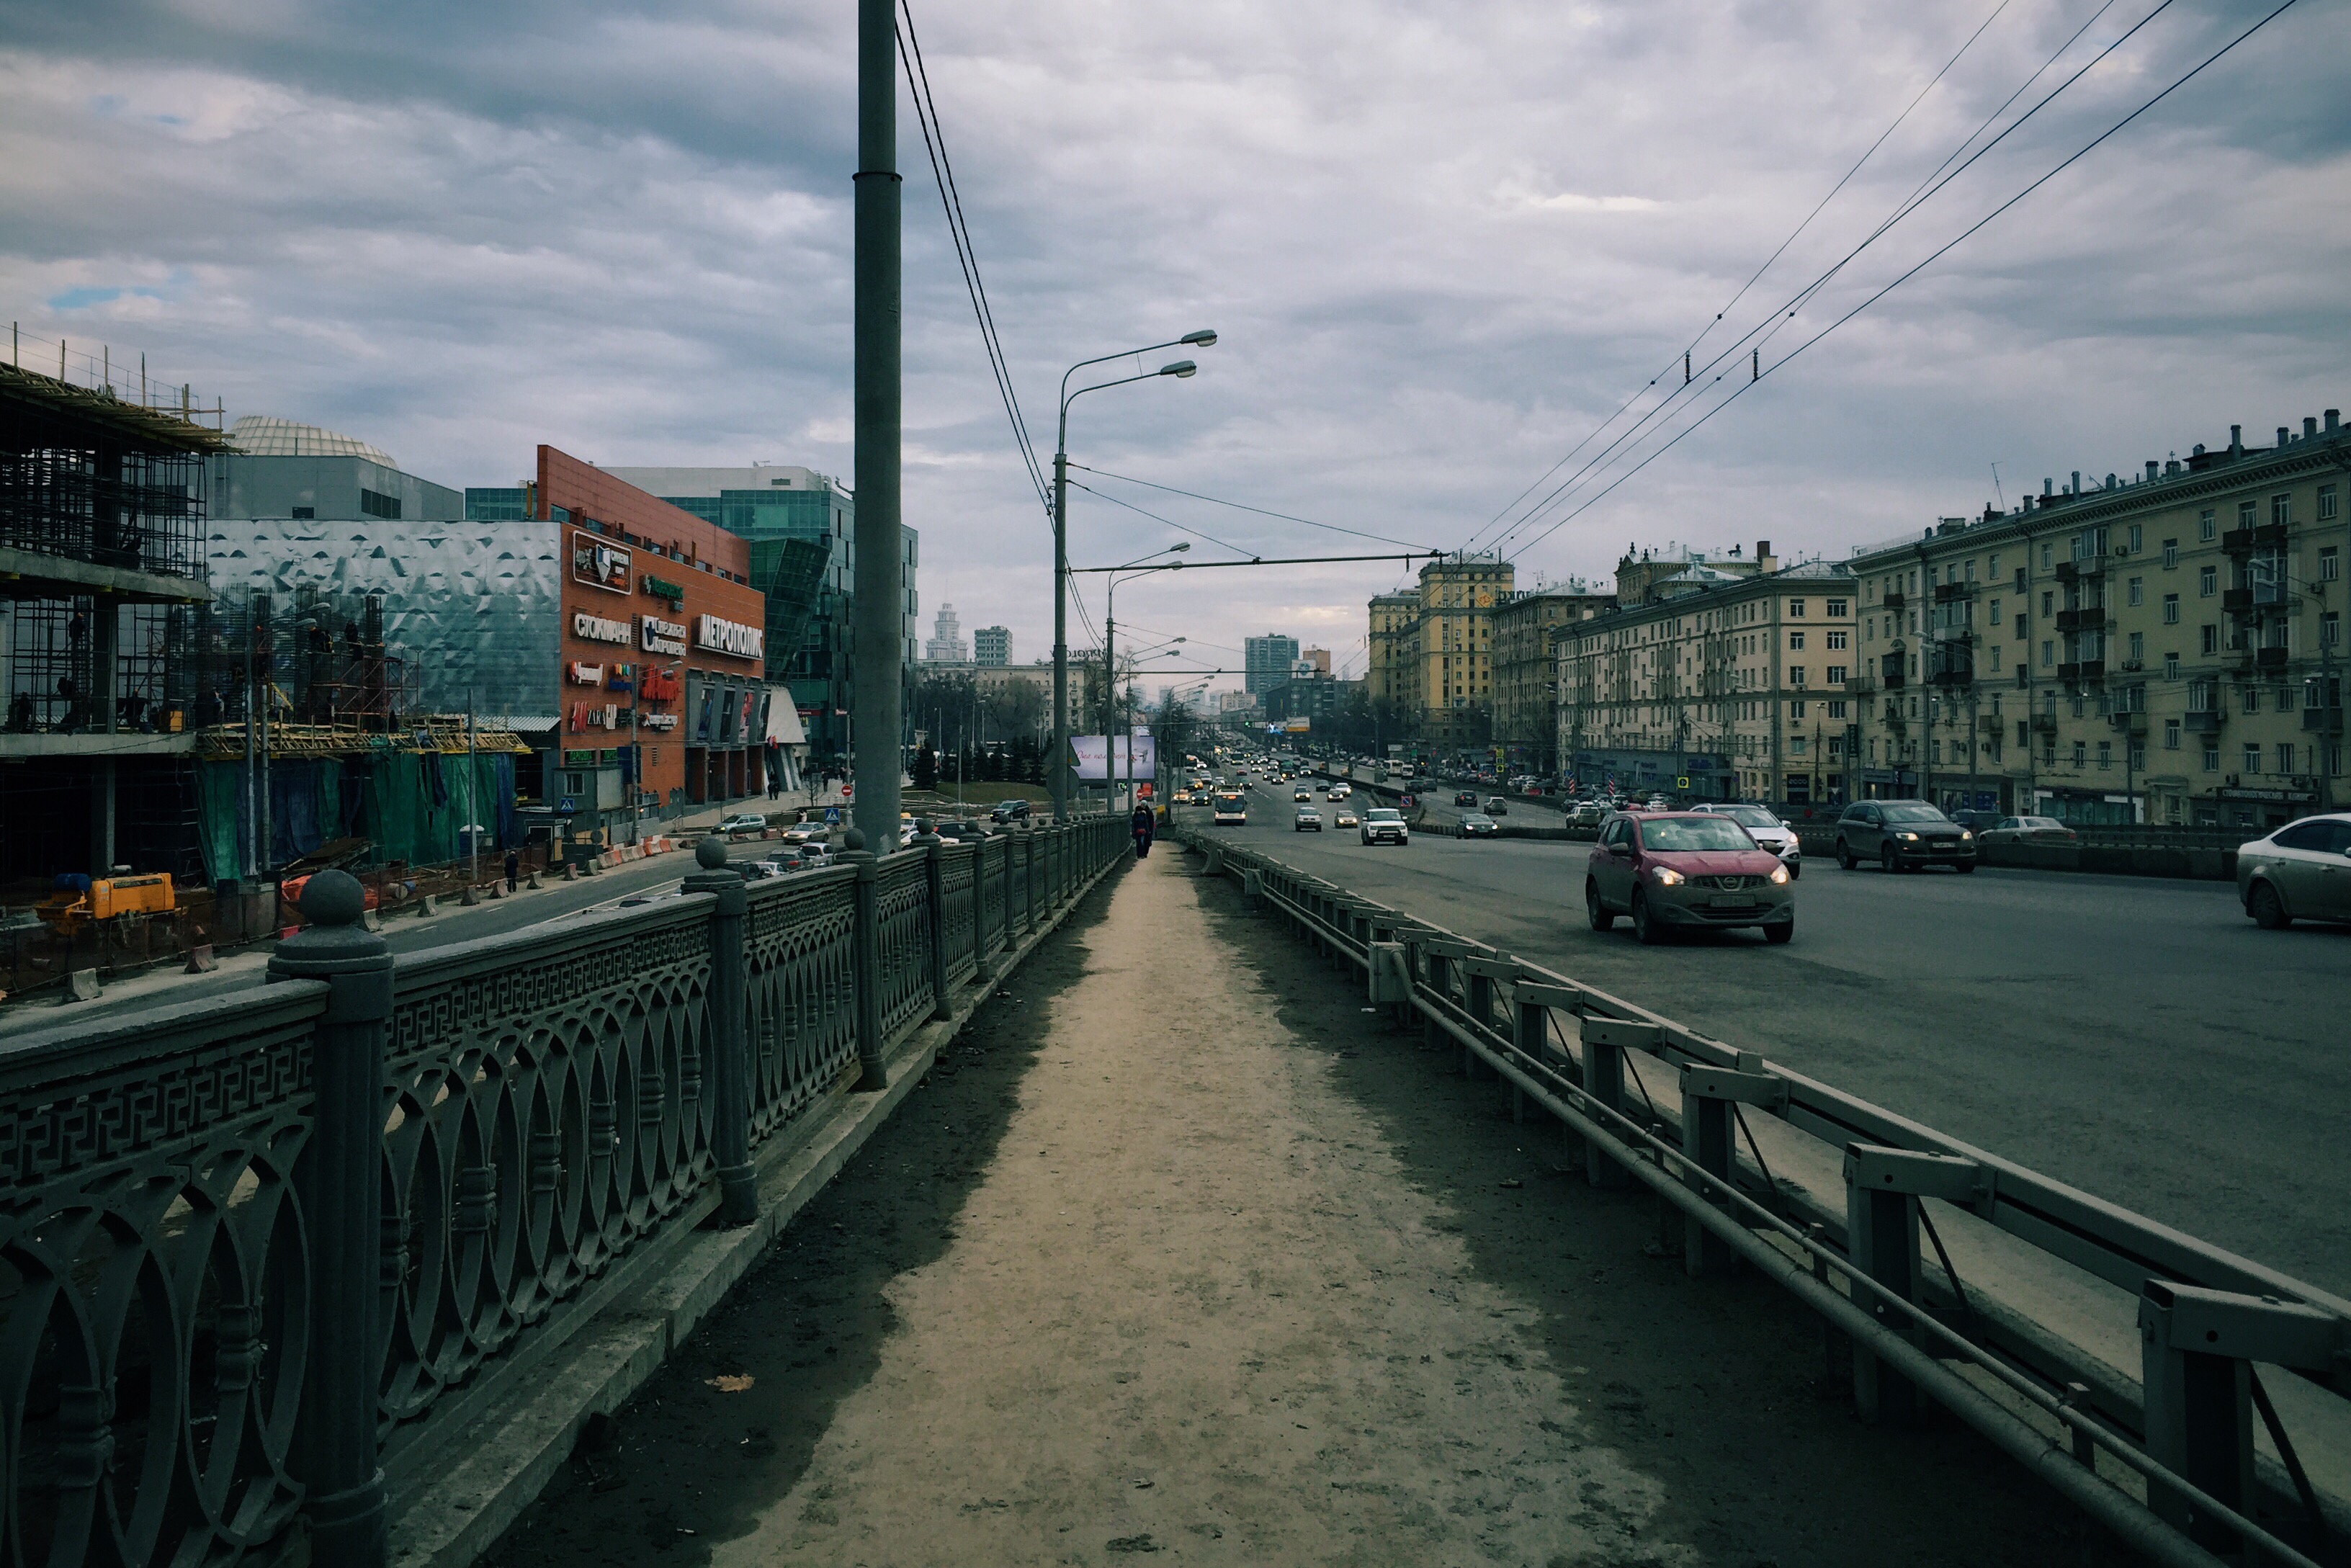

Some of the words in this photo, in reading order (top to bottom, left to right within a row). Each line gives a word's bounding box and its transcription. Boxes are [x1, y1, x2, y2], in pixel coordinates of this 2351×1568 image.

[575, 614, 631, 645] СТОКМАНН
[699, 614, 762, 658] МЕТРОПОЛИС
[587, 709, 606, 725] ZARA
